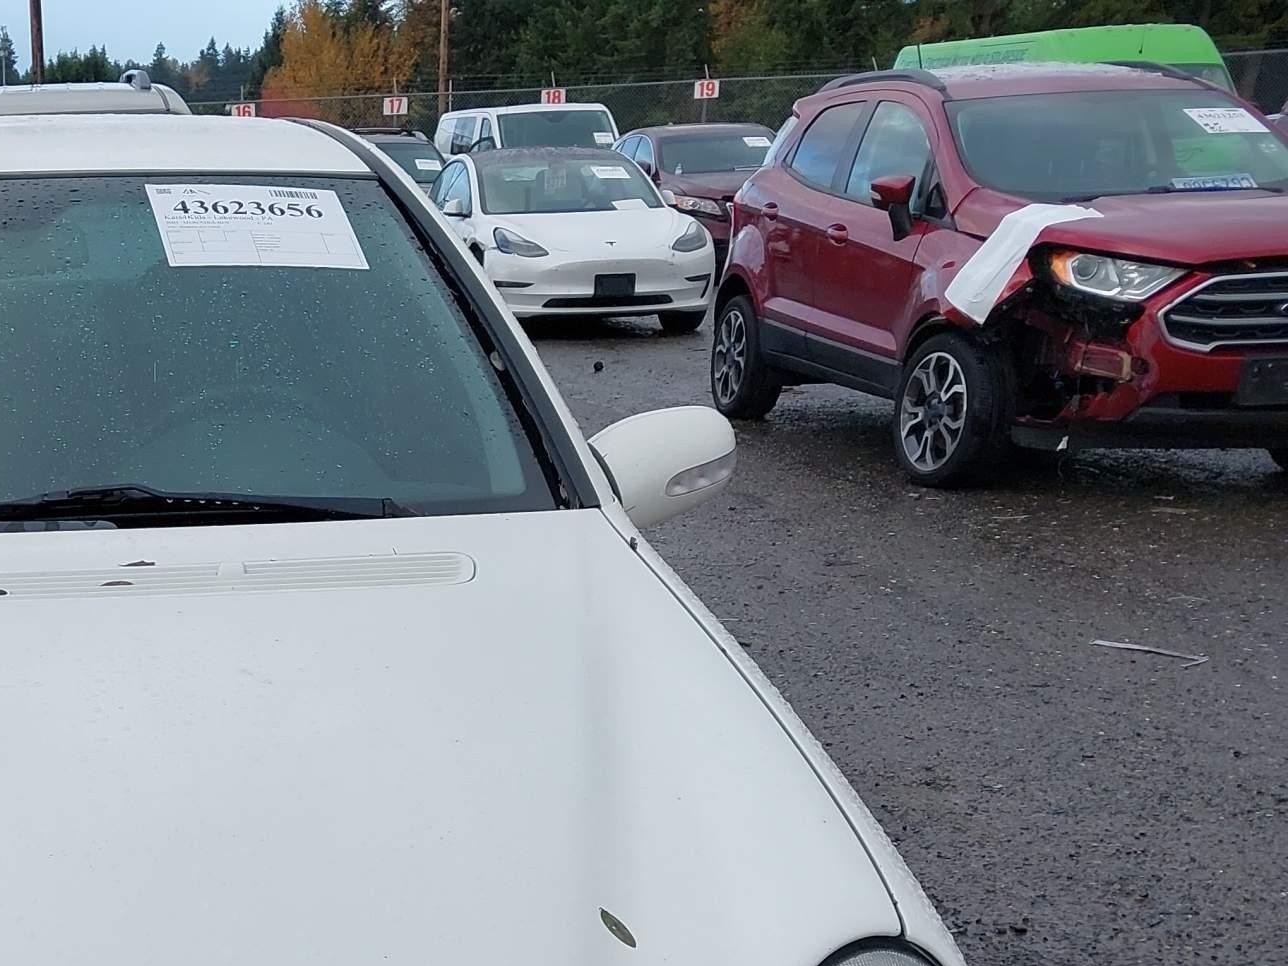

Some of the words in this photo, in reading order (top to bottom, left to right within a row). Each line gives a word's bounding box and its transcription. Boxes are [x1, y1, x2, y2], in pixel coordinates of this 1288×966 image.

[544, 90, 562, 104] 18
[698, 81, 716, 97] 19
[235, 105, 251, 117] 16
[388, 98, 402, 114] 17
[173, 199, 324, 219] 43623656
